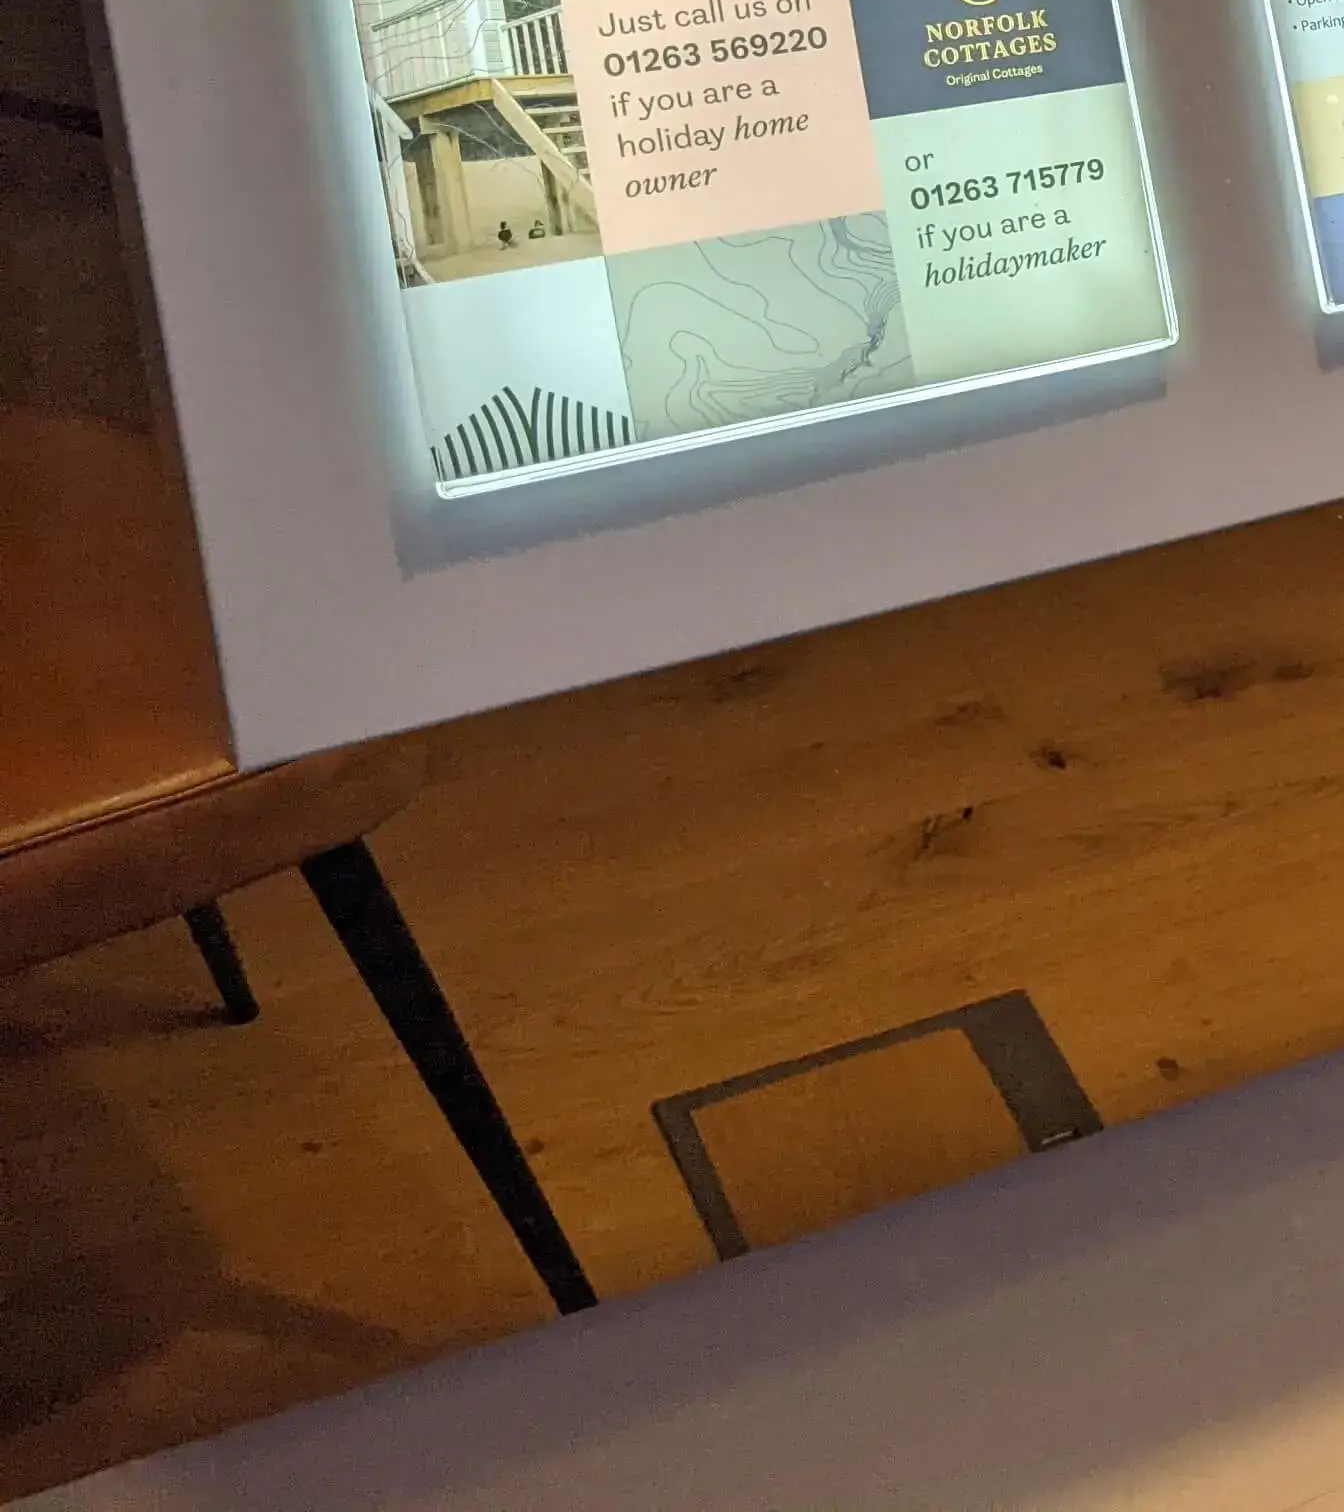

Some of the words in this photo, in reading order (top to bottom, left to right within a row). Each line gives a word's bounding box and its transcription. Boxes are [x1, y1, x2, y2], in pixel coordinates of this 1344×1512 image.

[597, 9, 666, 37] Just
[733, 0, 767, 20] us
[924, 8, 1048, 43] NORFOLK
[603, 42, 701, 76] 01263
[709, 25, 827, 62] 569220
[923, 32, 1056, 67] COTTAGES
[945, 69, 990, 86] Original
[991, 64, 1043, 79] Cottages
[610, 90, 631, 118] if
[637, 90, 693, 121] you
[702, 82, 752, 104] are
[760, 78, 780, 96] a
[616, 123, 725, 157] holiday
[733, 113, 808, 141] home
[904, 152, 934, 172] or
[624, 167, 717, 198] owner
[910, 175, 999, 210] 01263
[1005, 158, 1104, 194] 715779
[917, 222, 935, 249] if
[941, 221, 992, 252] you
[1000, 212, 1046, 234] are
[1053, 208, 1071, 225] a
[924, 236, 1106, 287] holidaymaker
